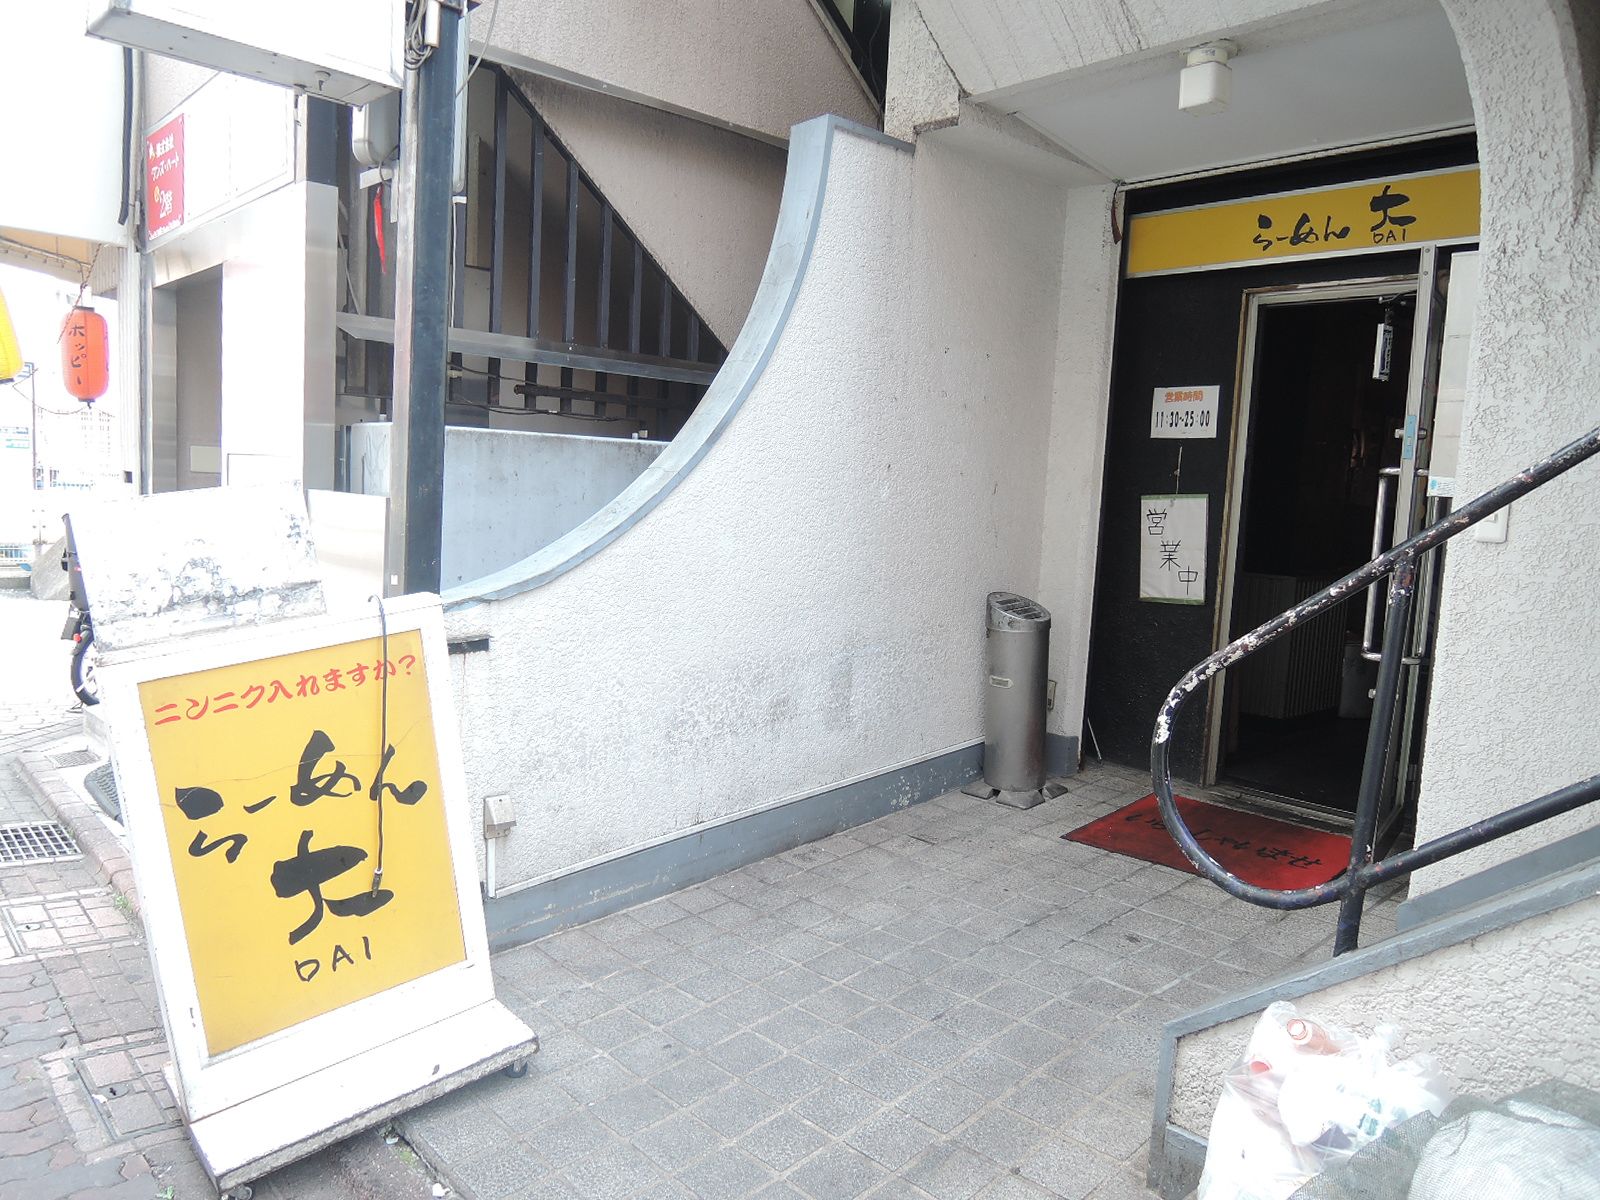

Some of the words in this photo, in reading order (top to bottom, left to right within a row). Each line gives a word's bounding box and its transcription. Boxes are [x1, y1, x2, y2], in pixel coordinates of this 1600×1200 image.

[1253, 212, 1351, 251] らーめん
[1370, 185, 1417, 232] 大
[1373, 229, 1407, 244] DAI
[68, 324, 87, 385] ホッピー
[1165, 390, 1204, 402] 営業時間
[1146, 508, 1199, 596] 営業中
[175, 730, 428, 864] らーめん
[270, 829, 394, 945] 大
[294, 936, 372, 982] DAI
